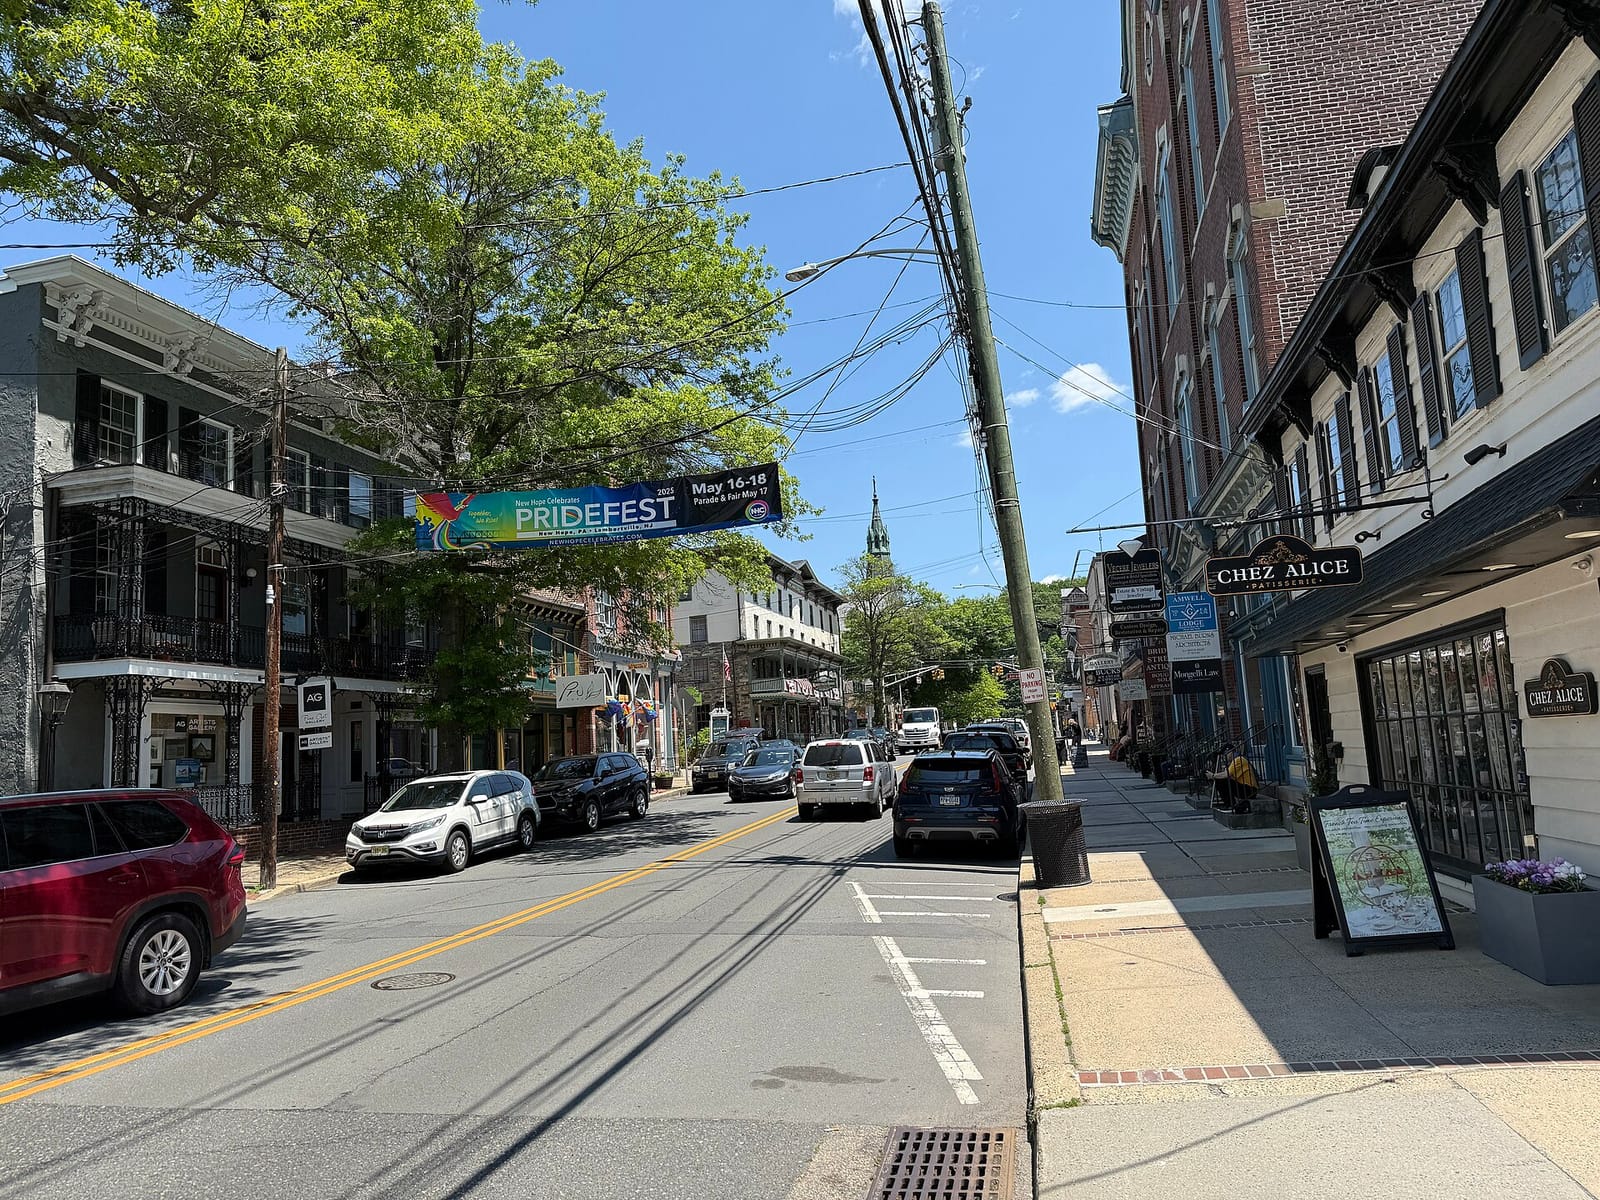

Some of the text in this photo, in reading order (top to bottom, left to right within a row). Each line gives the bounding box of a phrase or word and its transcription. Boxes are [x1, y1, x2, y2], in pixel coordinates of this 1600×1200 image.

[692, 473, 767, 495] May 16-18
[657, 487, 674, 496] 2025
[693, 487, 768, 505] Parade & Fair May 17
[530, 499, 546, 507] Hope
[547, 497, 580, 505] Celebrates
[515, 496, 675, 530] PRIDEFEST
[550, 533, 643, 545] NEWHOPECELEBRATES.COM
[1217, 559, 1349, 584] CHEZ ALICE
[1251, 578, 1317, 589] PATISSERIE
[1173, 594, 1205, 603] AMWELL
[1178, 620, 1205, 628] LODGE
[1147, 647, 1167, 655] BRID
[1027, 672, 1035, 680] NO
[1096, 668, 1120, 676] BUCKS
[1204, 668, 1219, 677] Law
[1022, 680, 1042, 689] PARKING
[306, 693, 323, 703] AG
[1529, 687, 1584, 706] CHEZ ALICE
